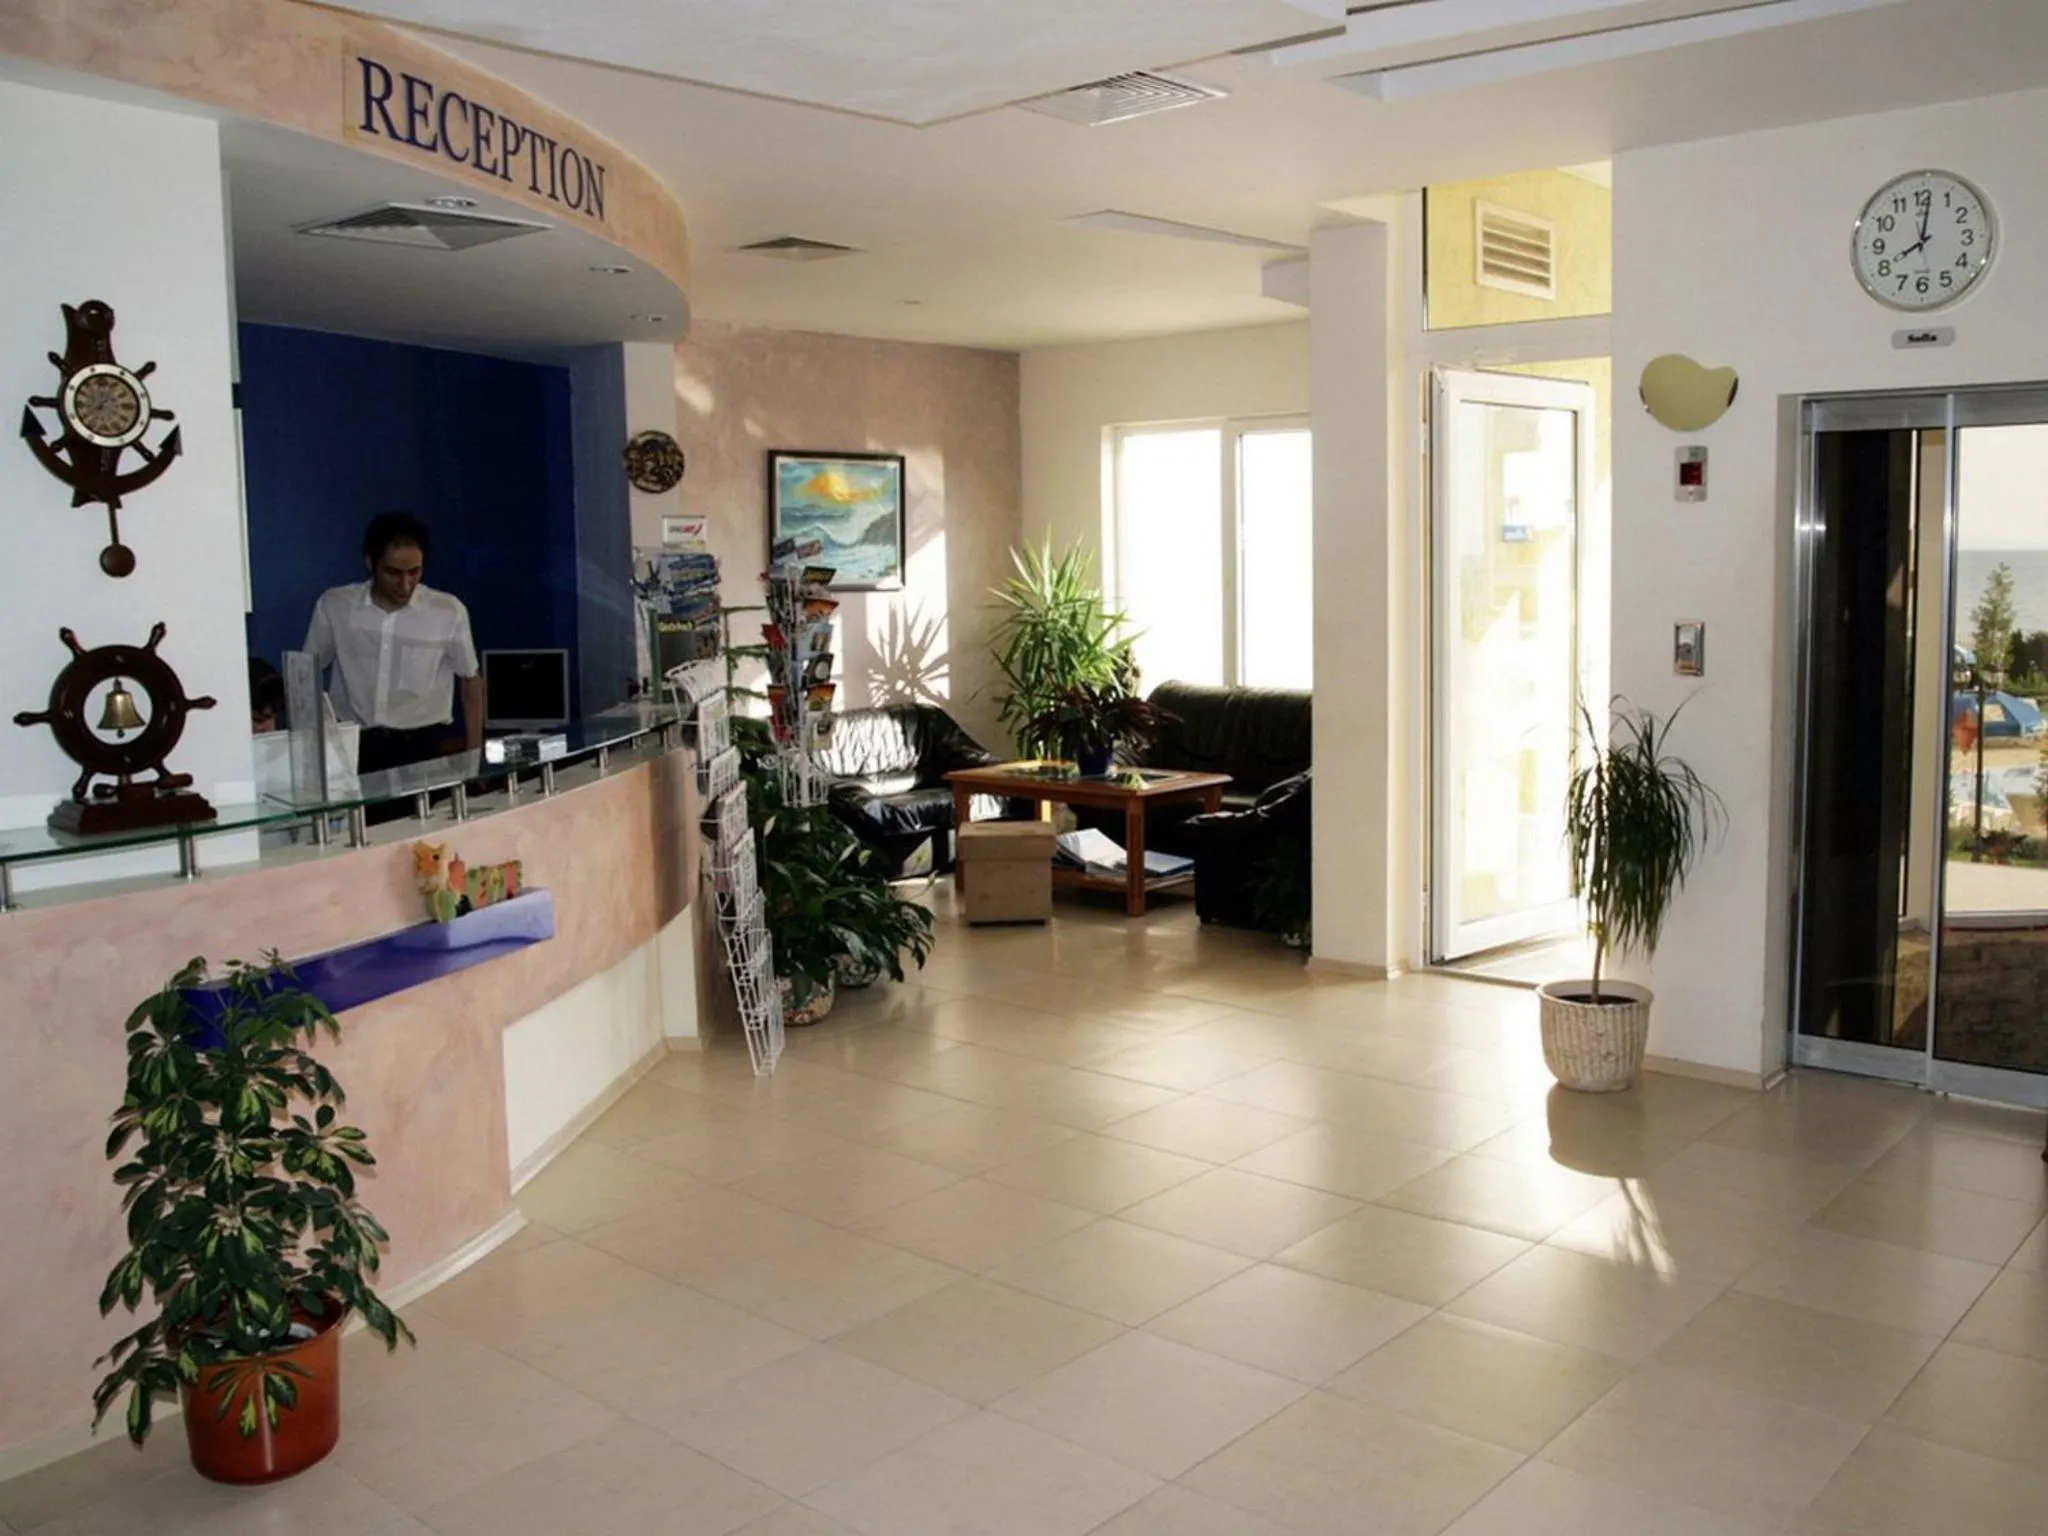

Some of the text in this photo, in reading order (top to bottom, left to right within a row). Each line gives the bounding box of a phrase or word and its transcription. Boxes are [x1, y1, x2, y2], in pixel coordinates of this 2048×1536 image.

[357, 57, 605, 222] RECEPTION
[1892, 197, 1906, 213] 11
[1913, 189, 1932, 206] 12
[1943, 192, 1951, 207] 1
[1876, 215, 1895, 232] 10
[1955, 206, 1969, 224] 2
[1961, 228, 1974, 246] 3
[1872, 238, 1885, 255] 9
[1878, 259, 1891, 277] 8
[1955, 252, 1968, 268] 4
[1896, 275, 1909, 291] 7
[1915, 276, 1929, 293] 6
[1939, 270, 1953, 288] 5
